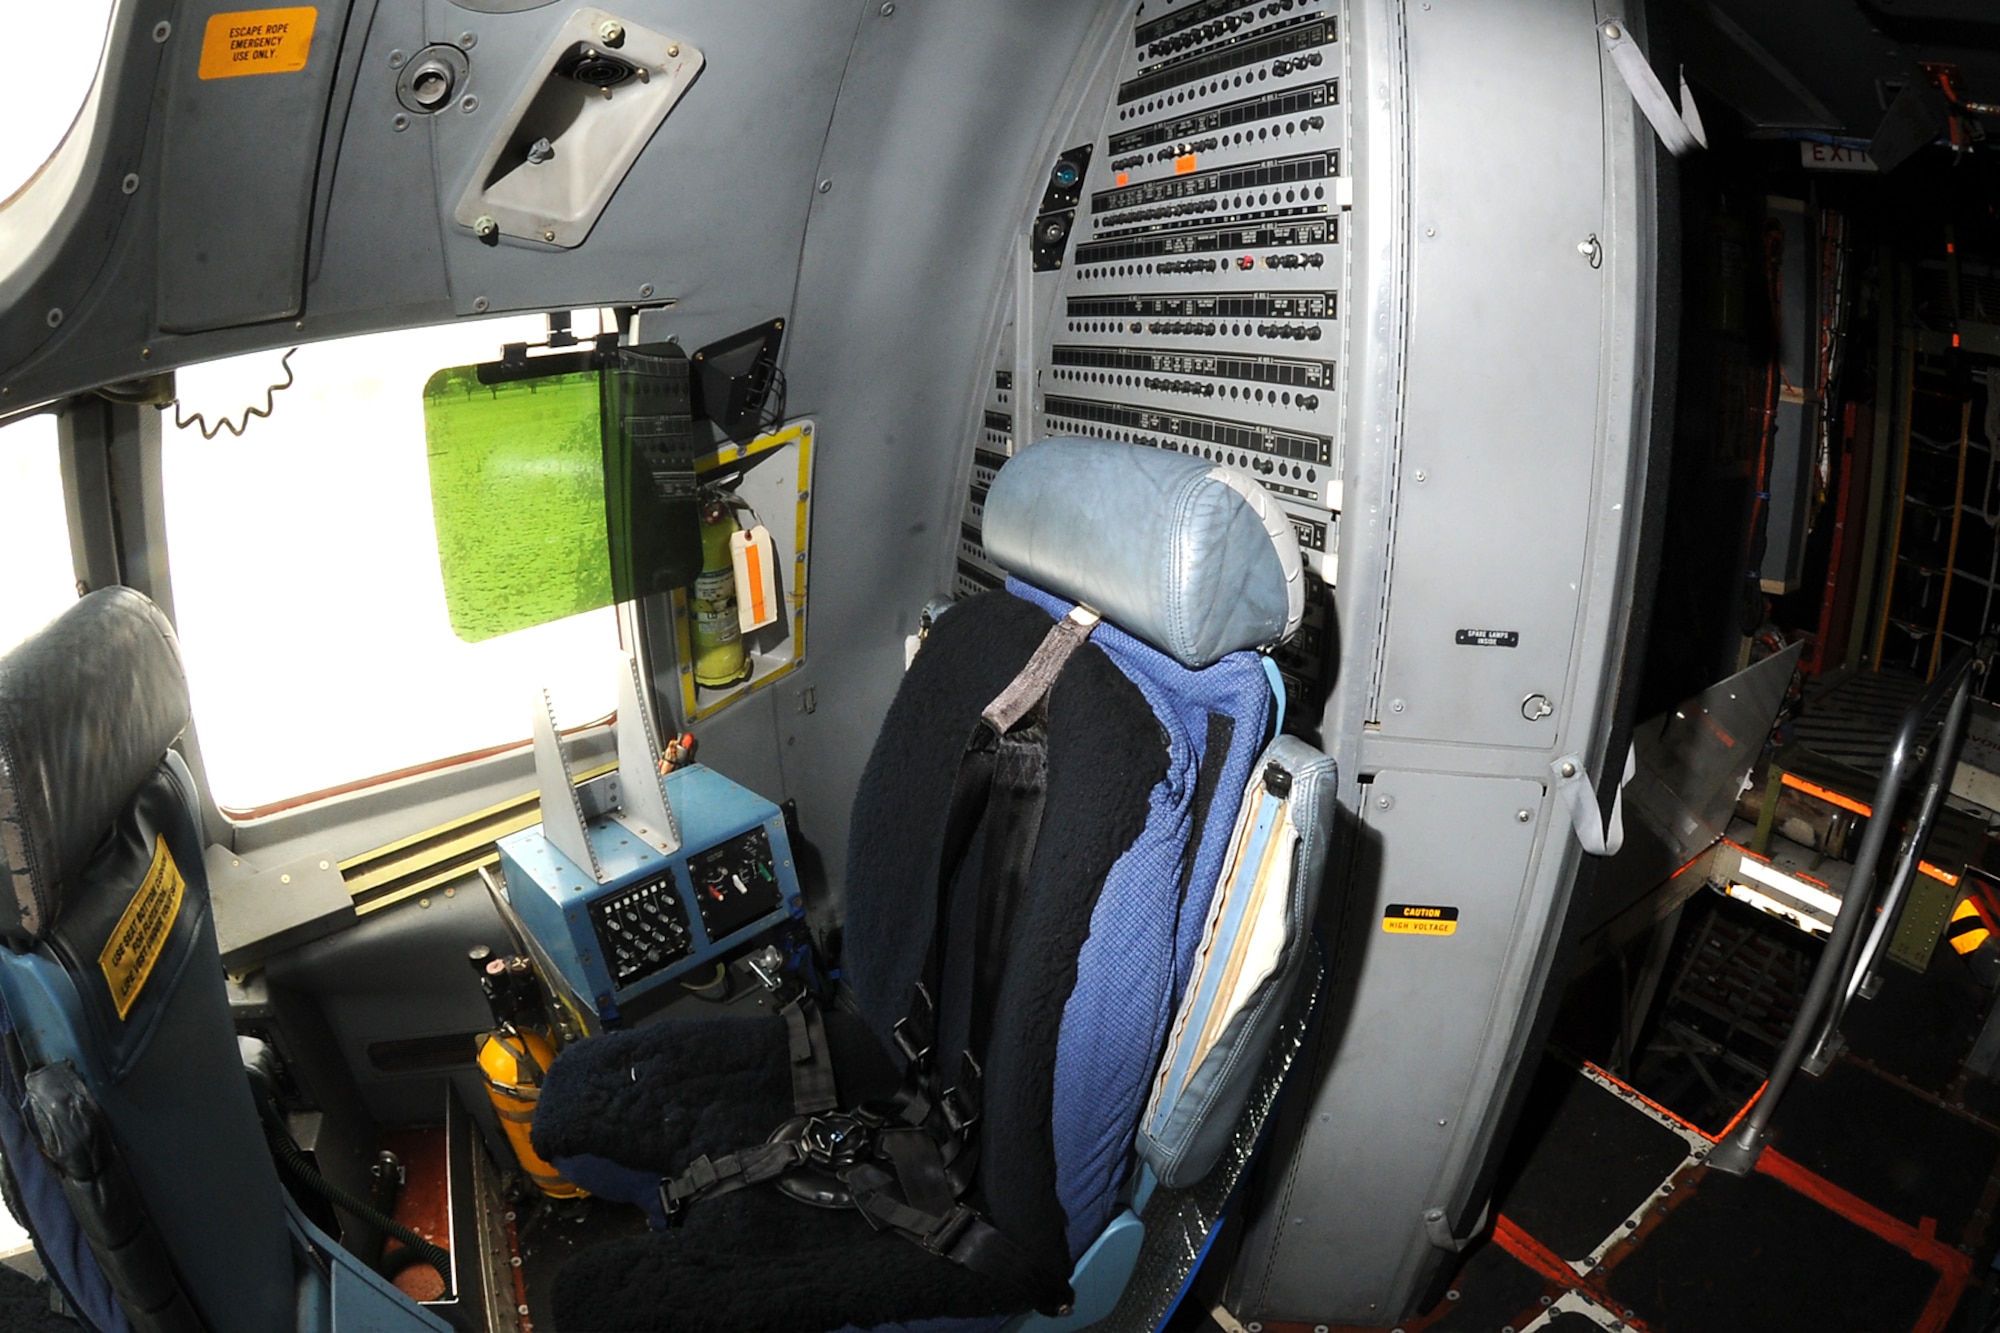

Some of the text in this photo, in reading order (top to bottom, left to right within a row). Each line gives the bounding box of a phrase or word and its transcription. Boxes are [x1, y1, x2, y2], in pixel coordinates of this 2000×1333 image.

[229, 23, 289, 38] ESCAPE ROPE
[230, 36, 283, 50] EMERGENCY
[233, 51, 250, 62] USE
[1467, 630, 1509, 639] SPARE LAMPS
[1403, 907, 1441, 917] CAUTION
[112, 945, 125, 968] USE
[123, 919, 138, 947] SEAT
[136, 885, 157, 922] BOTTOM
[1389, 921, 1449, 932] HIGH VOLTAGE
[132, 929, 146, 954] FOR
[121, 970, 136, 997] LIFE
